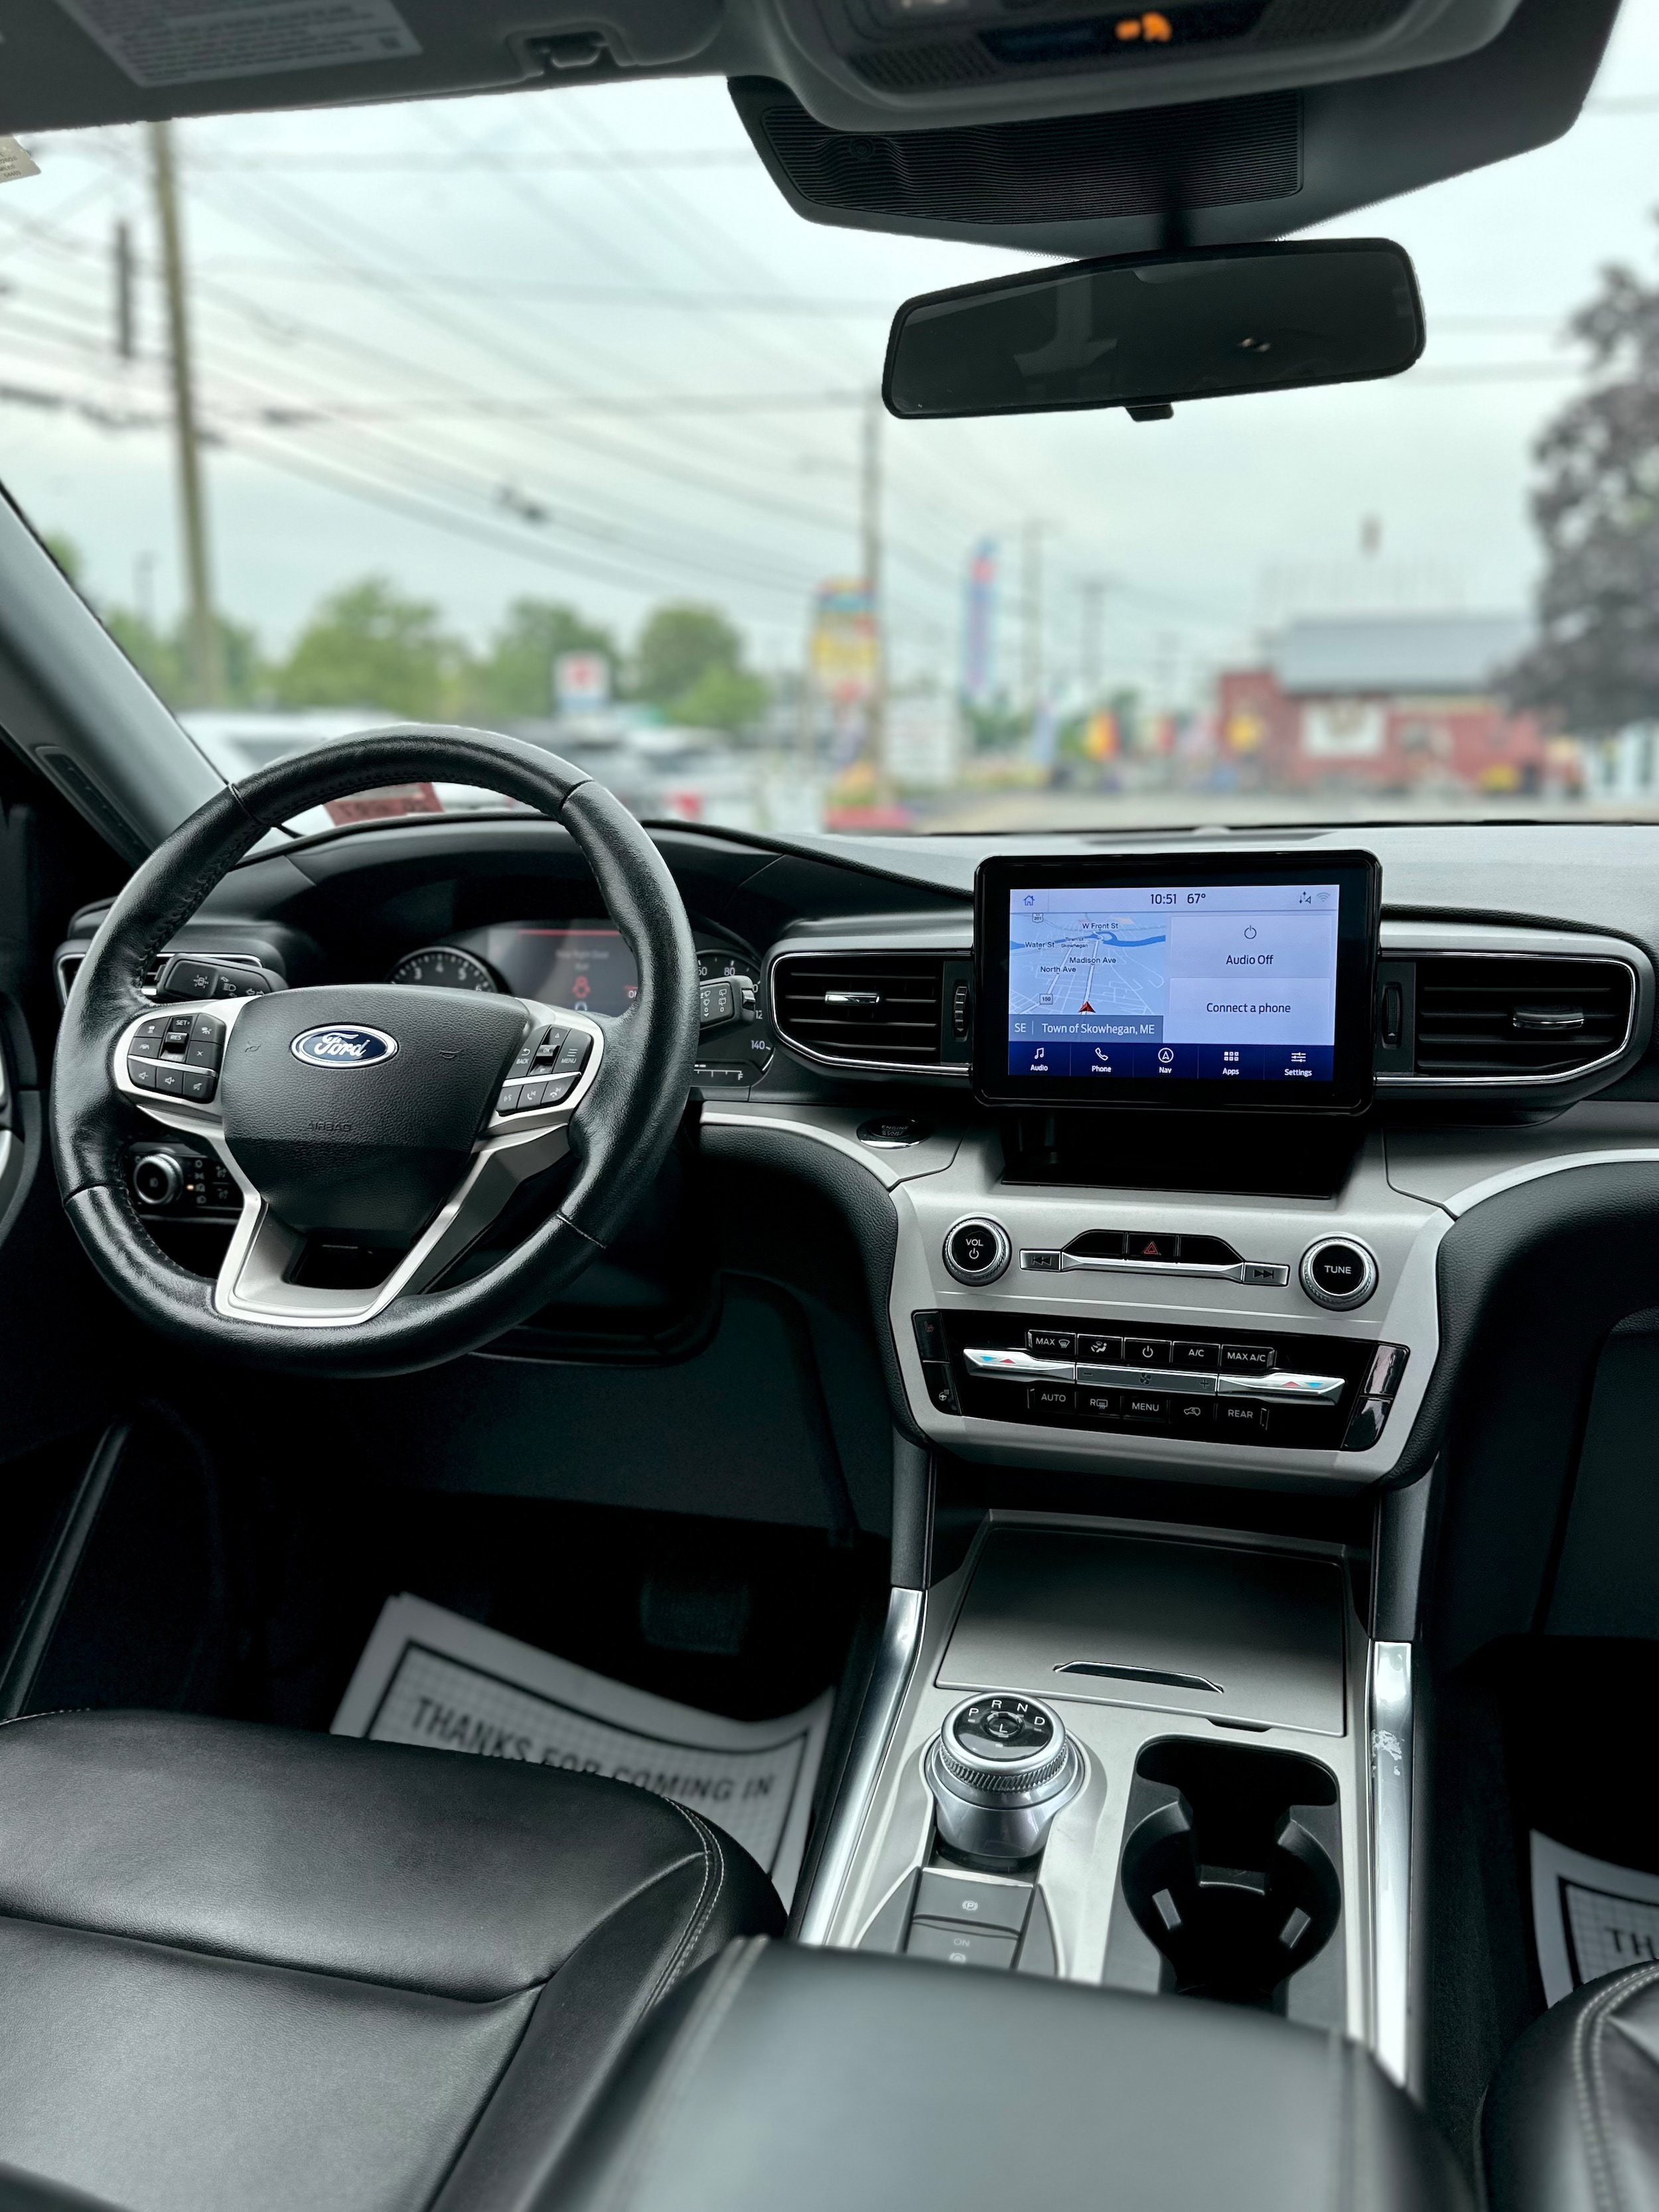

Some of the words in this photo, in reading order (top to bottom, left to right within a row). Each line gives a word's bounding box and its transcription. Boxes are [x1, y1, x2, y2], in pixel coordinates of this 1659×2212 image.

[1150, 894, 1177, 904] 10:51
[1187, 893, 1206, 904] 67°
[1226, 955, 1256, 965] Audio
[1257, 954, 1274, 965] Off
[724, 967, 736, 976] 80
[1206, 1002, 1248, 1012] Connect
[1258, 1002, 1291, 1014] phone
[1014, 1022, 1027, 1033] SE
[1041, 1023, 1067, 1034] Town
[1068, 1023, 1080, 1034] of
[1080, 1023, 1139, 1036] Skowhegan,
[1139, 1024, 1155, 1034] ME
[314, 1032, 371, 1058] Ford
[751, 1040, 766, 1050] 140
[1222, 1068, 1240, 1076] Apps
[1284, 1069, 1313, 1077] Settings
[307, 1121, 352, 1133] AIRBAG
[966, 1238, 984, 1247] VOL
[1324, 1265, 1352, 1275] TUNE
[1035, 1338, 1055, 1346] MAX
[1188, 1349, 1204, 1357] A/C
[1227, 1352, 1249, 1361] MAX
[1250, 1353, 1266, 1362] A/C
[1041, 1393, 1066, 1403] AUTO
[1131, 1402, 1159, 1412] MENU
[1228, 1409, 1254, 1419] REAR
[968, 1708, 979, 1716] P
[991, 1699, 1003, 1709] R
[1017, 1702, 1029, 1712] N
[1034, 1716, 1046, 1726] D
[999, 1724, 1008, 1733] L
[742, 1772, 776, 1800] IN
[953, 1938, 970, 1947] ON
